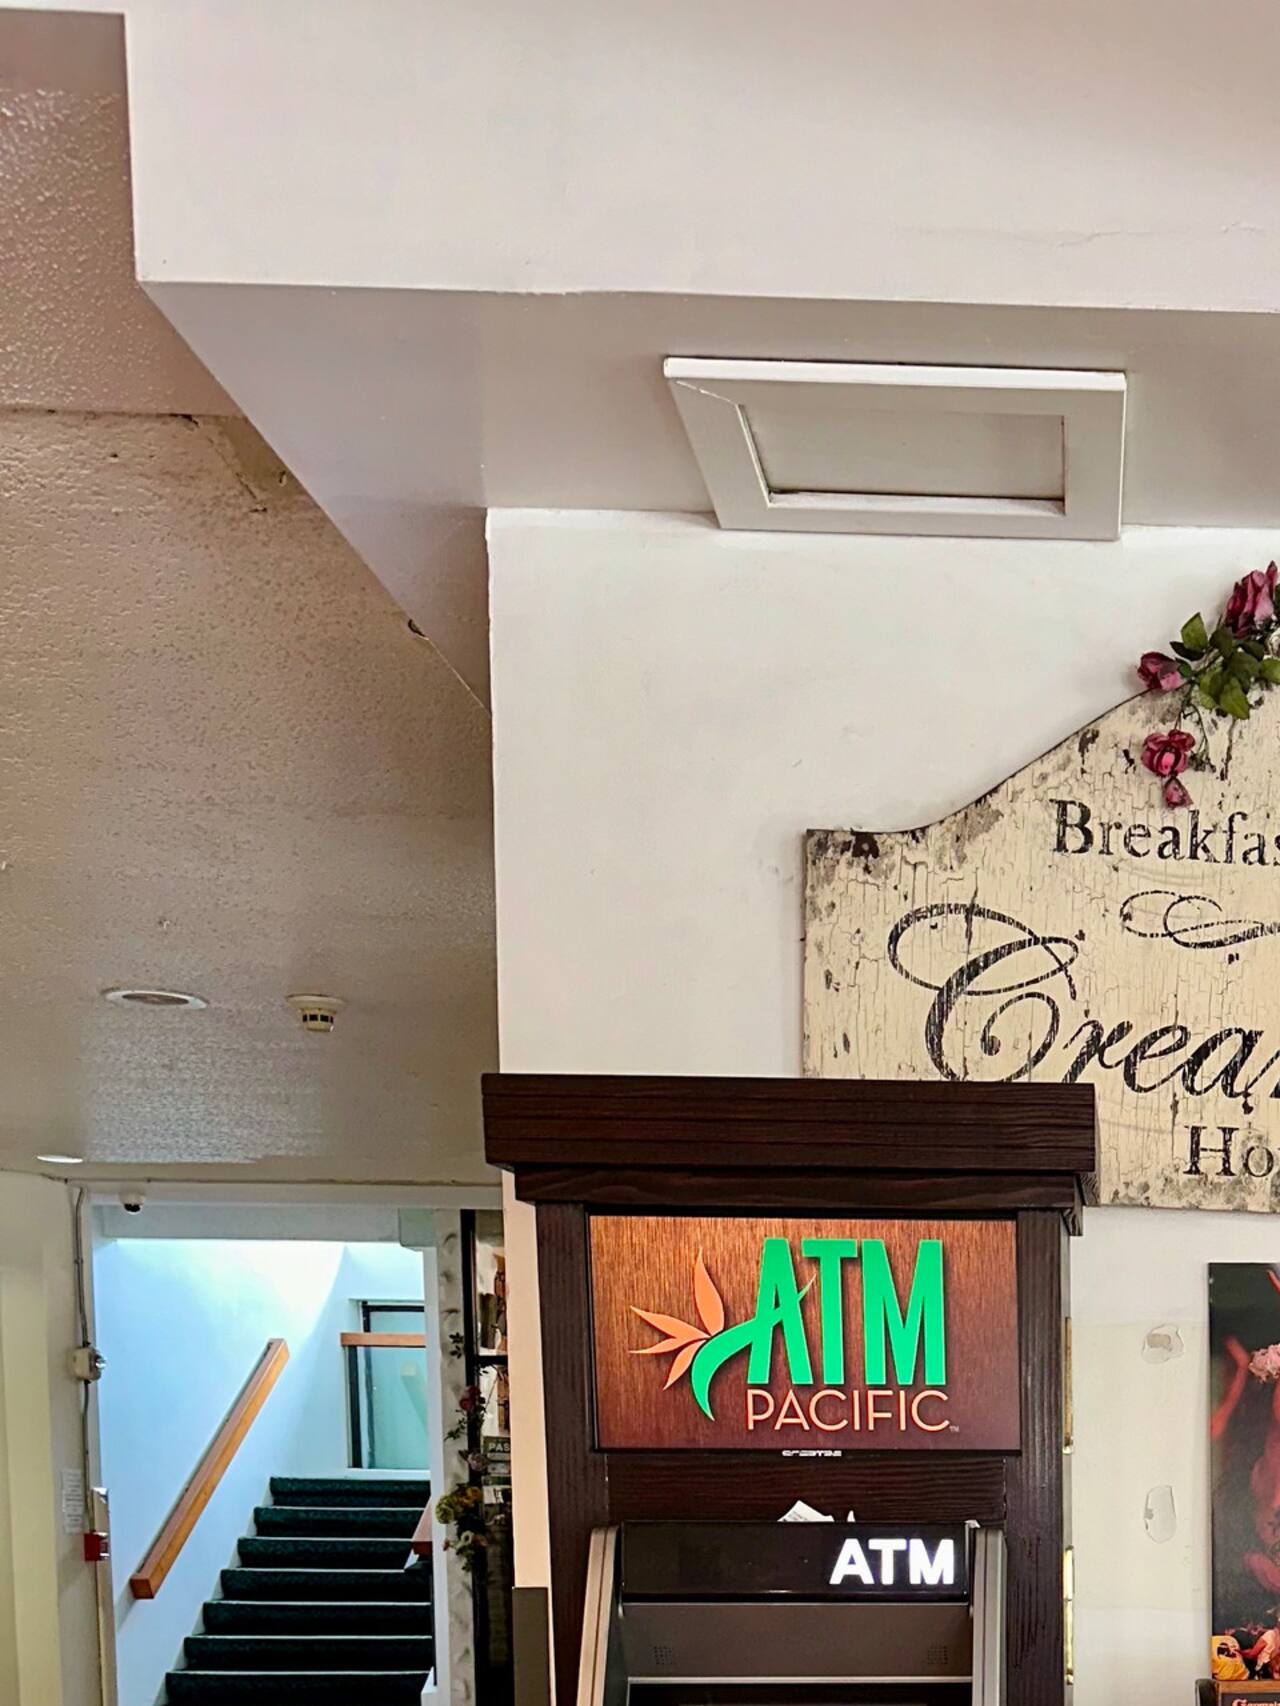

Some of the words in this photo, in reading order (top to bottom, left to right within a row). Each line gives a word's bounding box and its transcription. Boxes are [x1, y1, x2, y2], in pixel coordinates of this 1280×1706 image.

[742, 1237, 947, 1386] ATM
[745, 1388, 950, 1434] PACIFIC
[828, 1537, 956, 1586] ATM
